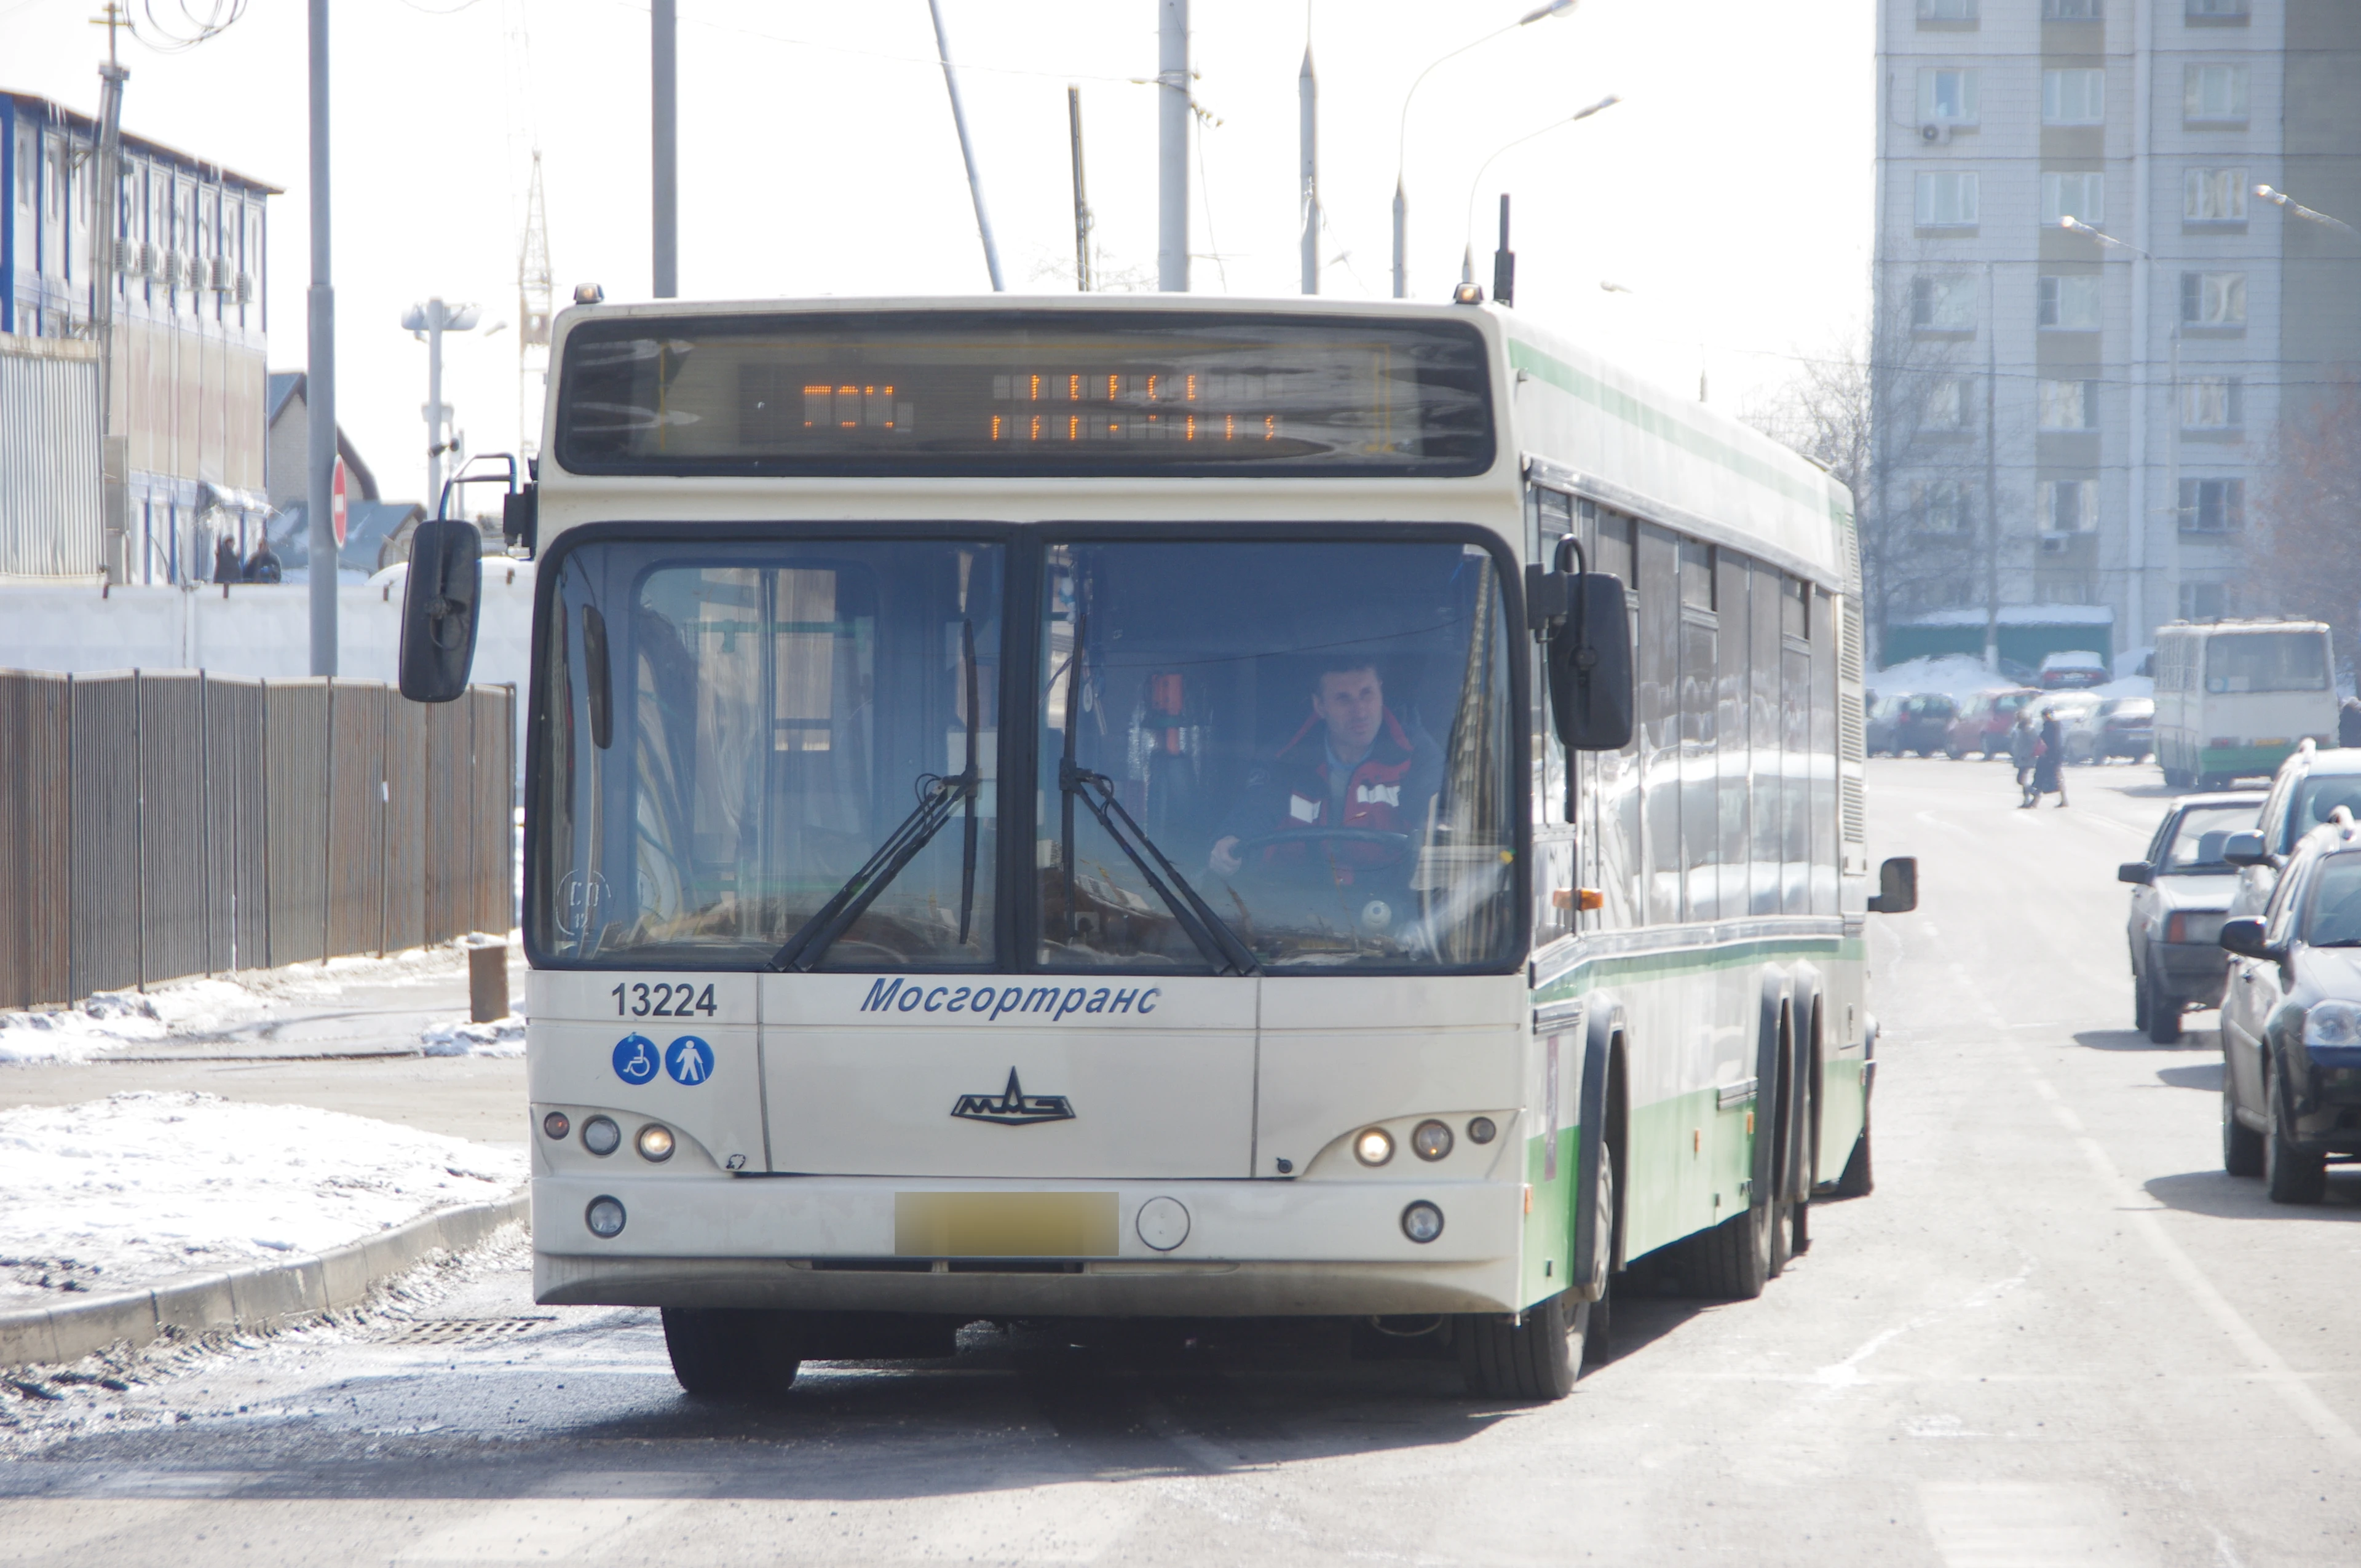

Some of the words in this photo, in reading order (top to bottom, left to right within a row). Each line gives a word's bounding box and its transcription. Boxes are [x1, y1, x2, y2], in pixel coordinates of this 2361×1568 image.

[611, 982, 718, 1017] 13224
[861, 977, 1163, 1021] Мосгортранс
[958, 1065, 1070, 1115] МАЗ
